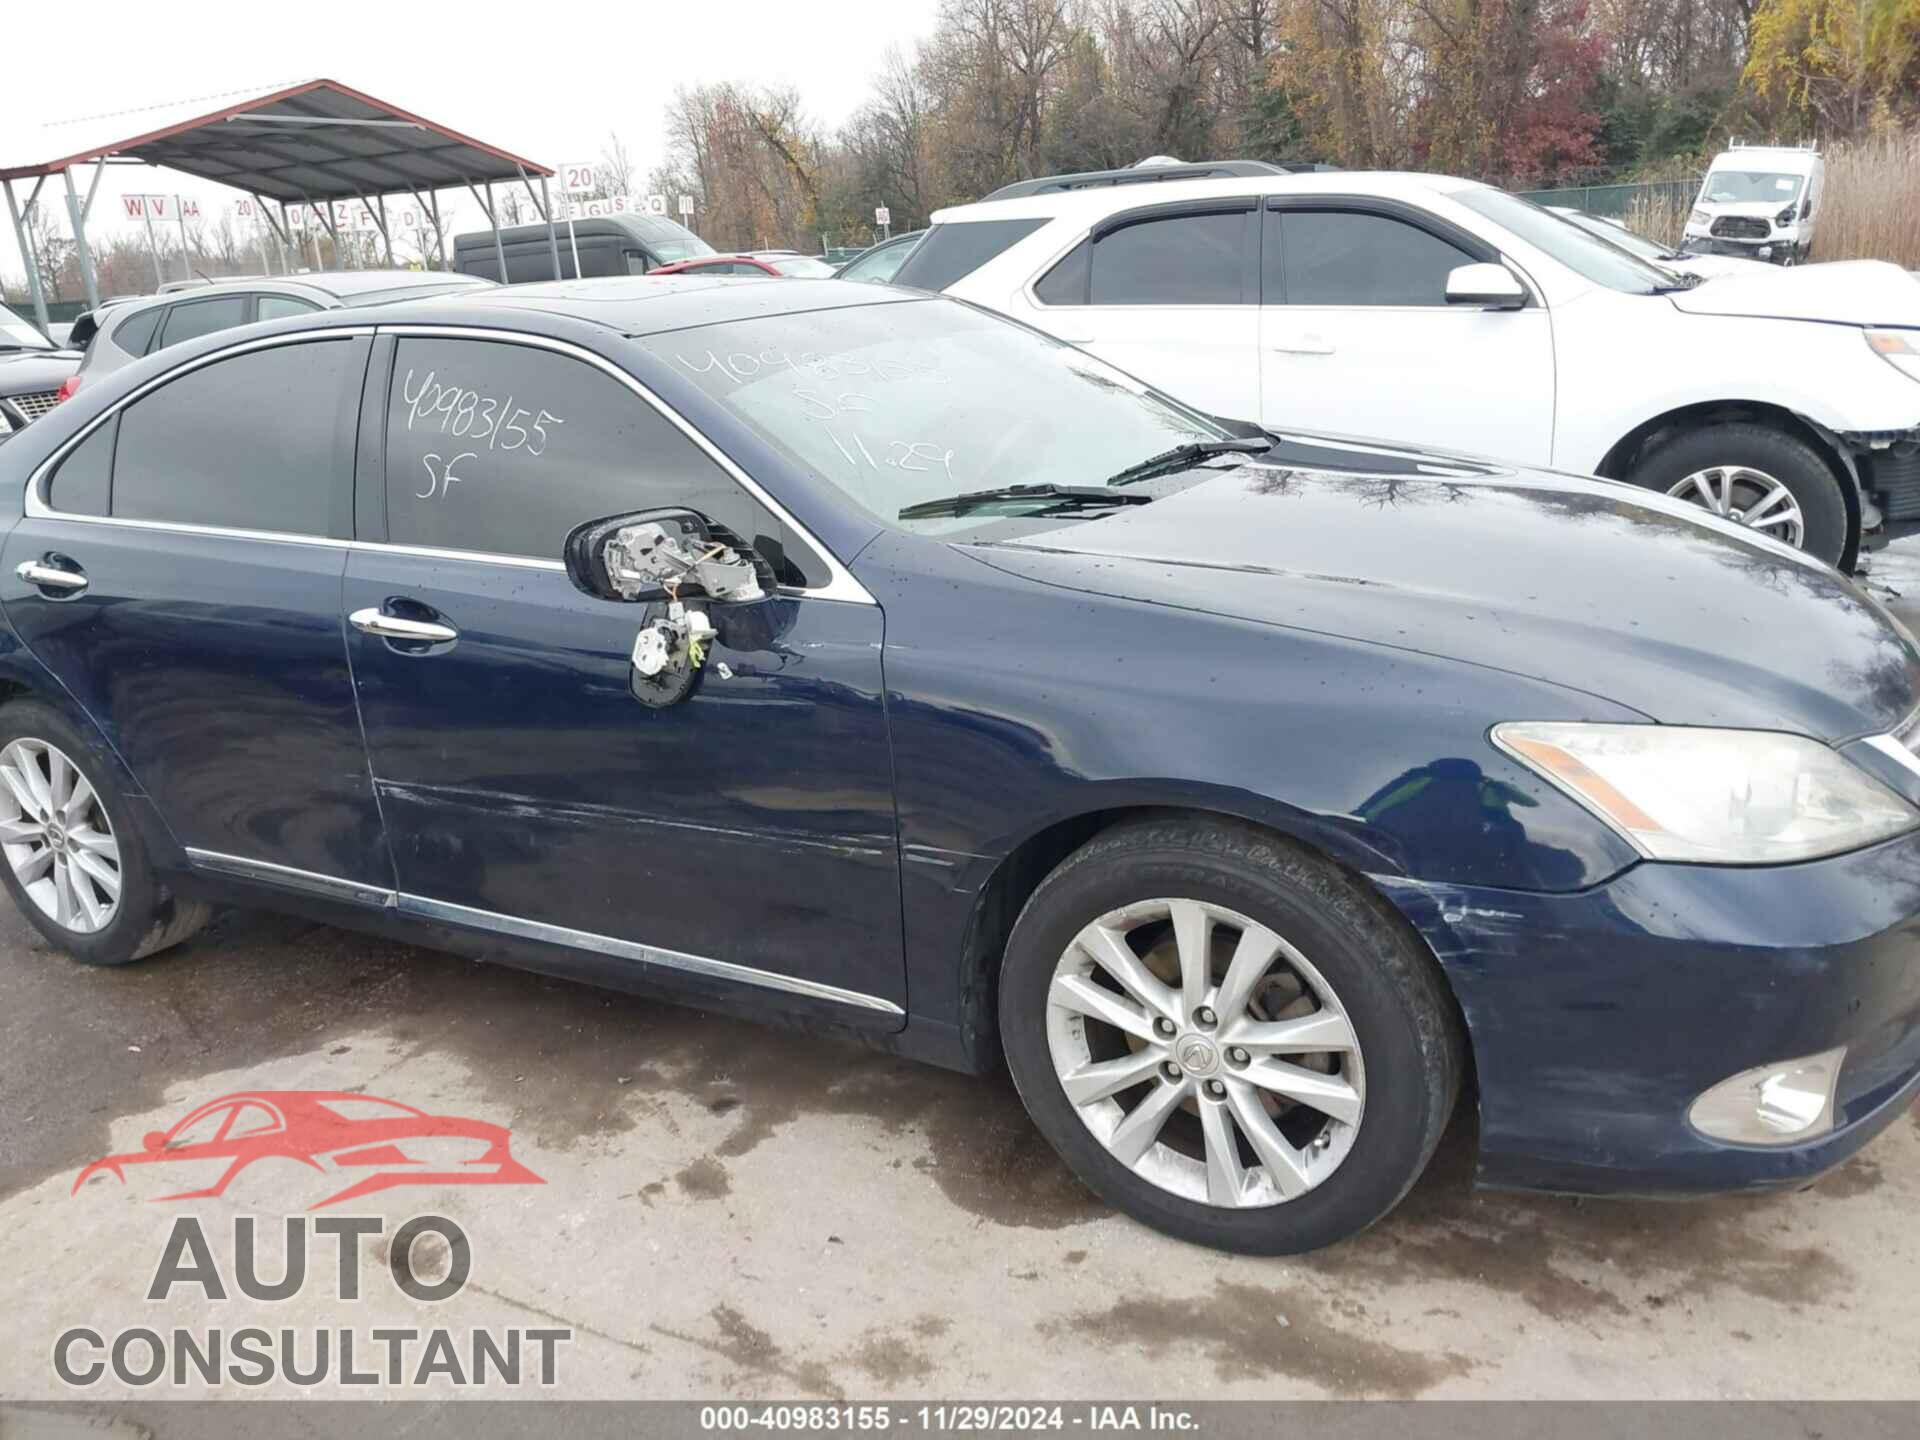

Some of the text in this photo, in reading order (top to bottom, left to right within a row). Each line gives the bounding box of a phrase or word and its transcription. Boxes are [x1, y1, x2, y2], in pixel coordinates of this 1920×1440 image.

[568, 168, 591, 187] 20
[124, 199, 142, 216] W
[152, 199, 163, 216] V
[676, 349, 952, 386] 409831
[403, 369, 564, 456] 40983155
[415, 452, 478, 499] SF
